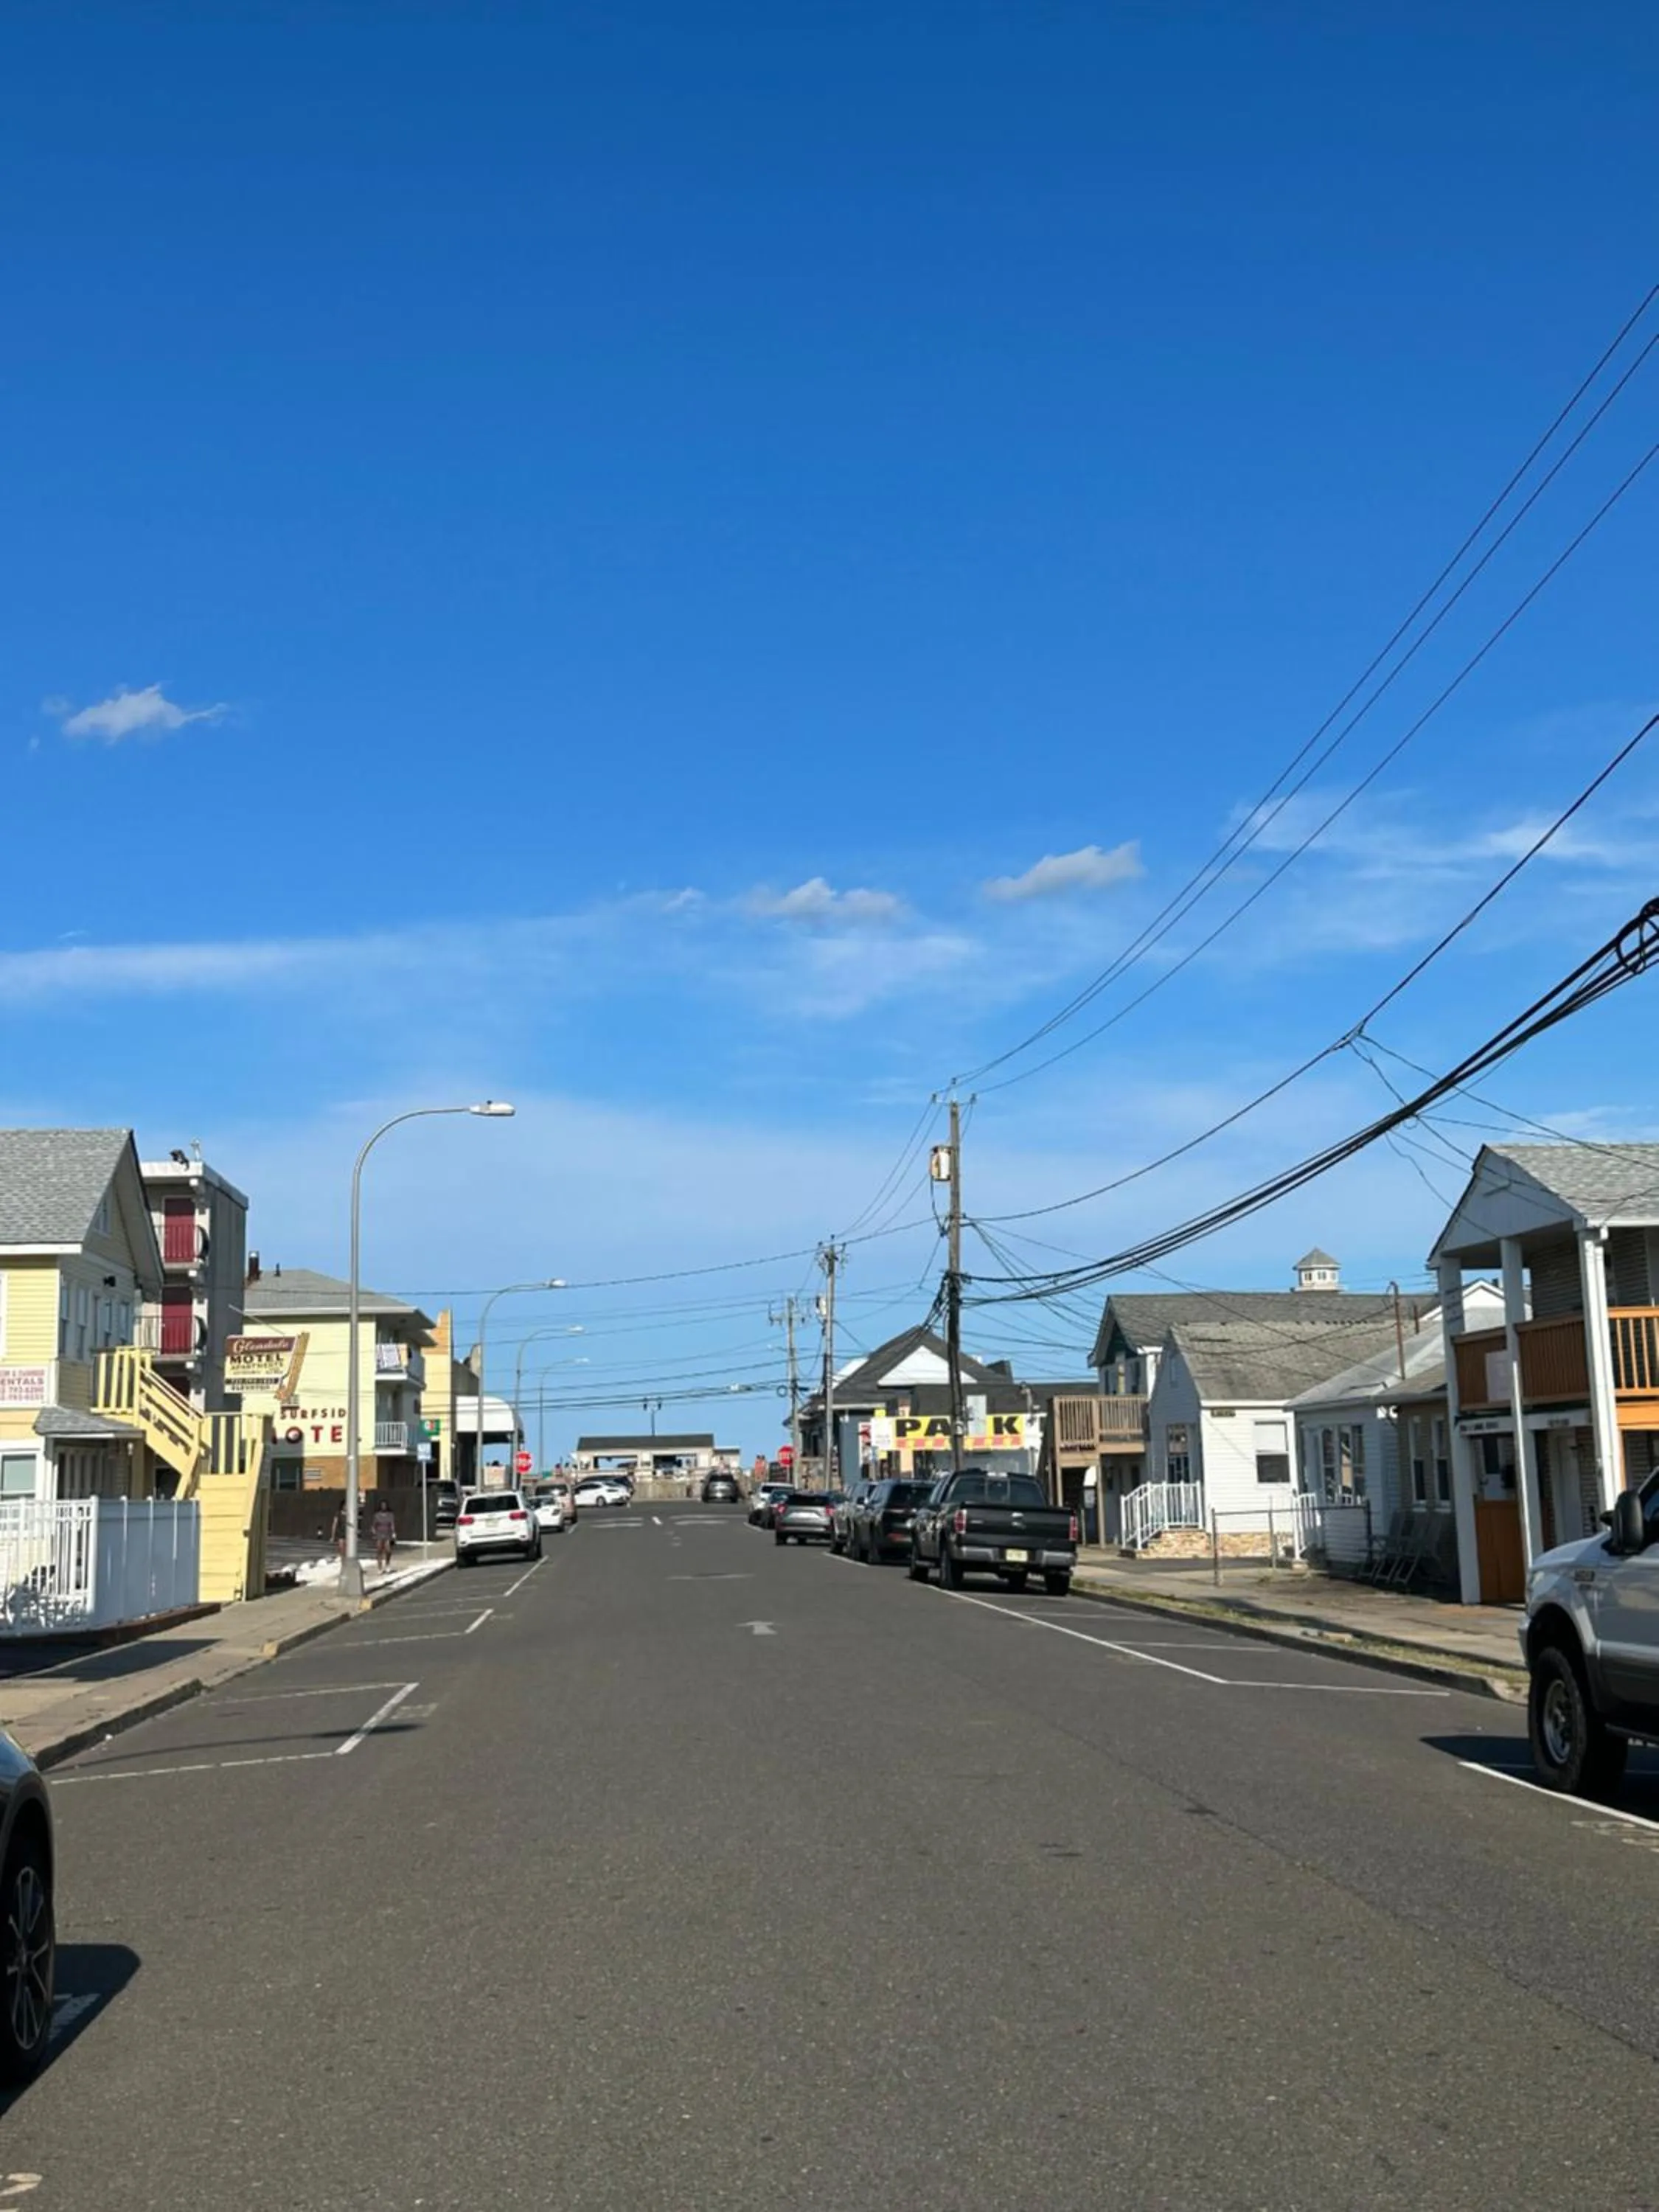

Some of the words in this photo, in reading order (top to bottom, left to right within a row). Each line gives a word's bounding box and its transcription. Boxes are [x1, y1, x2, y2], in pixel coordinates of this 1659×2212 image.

[230, 1353, 284, 1363] MOTEL
[0, 1377, 44, 1385] ENTALS
[280, 1408, 347, 1419] SURFSID
[896, 1416, 1020, 1437] PAK
[271, 1426, 361, 1444] OTE
